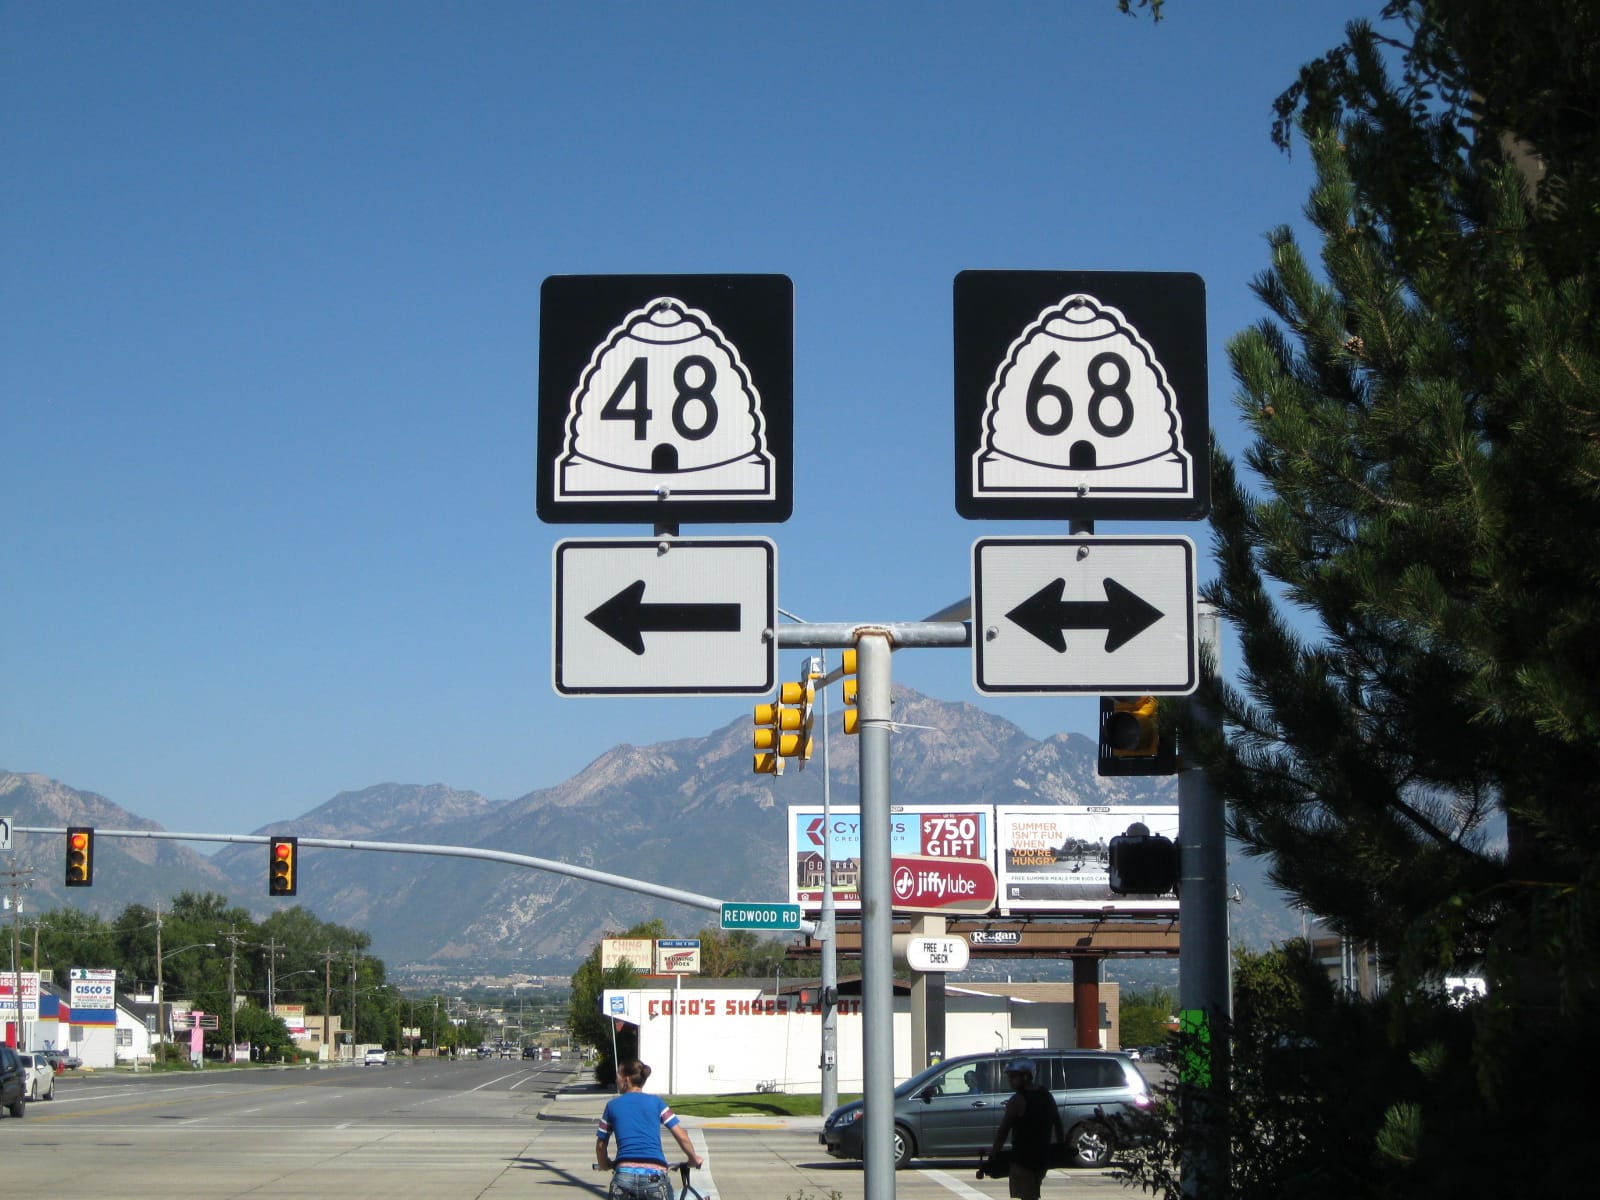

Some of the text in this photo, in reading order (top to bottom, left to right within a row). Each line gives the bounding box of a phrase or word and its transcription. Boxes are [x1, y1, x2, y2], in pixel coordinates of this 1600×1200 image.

[600, 355, 719, 441] 48
[1025, 351, 1134, 438] 68
[834, 822, 905, 833] CYS
[924, 818, 976, 841] $750
[1011, 823, 1057, 831] SUMMER
[1012, 832, 1063, 840] ISN'T FUN
[927, 840, 974, 856] GIFT
[1012, 840, 1045, 849] WHEN
[1012, 849, 1052, 857] YOU'RE
[1012, 857, 1057, 865] HUNGRY
[724, 910, 797, 922] REDWOOD RD
[923, 943, 937, 953] FREE
[930, 954, 949, 964] CHECK
[76, 986, 112, 994] CISCO'S
